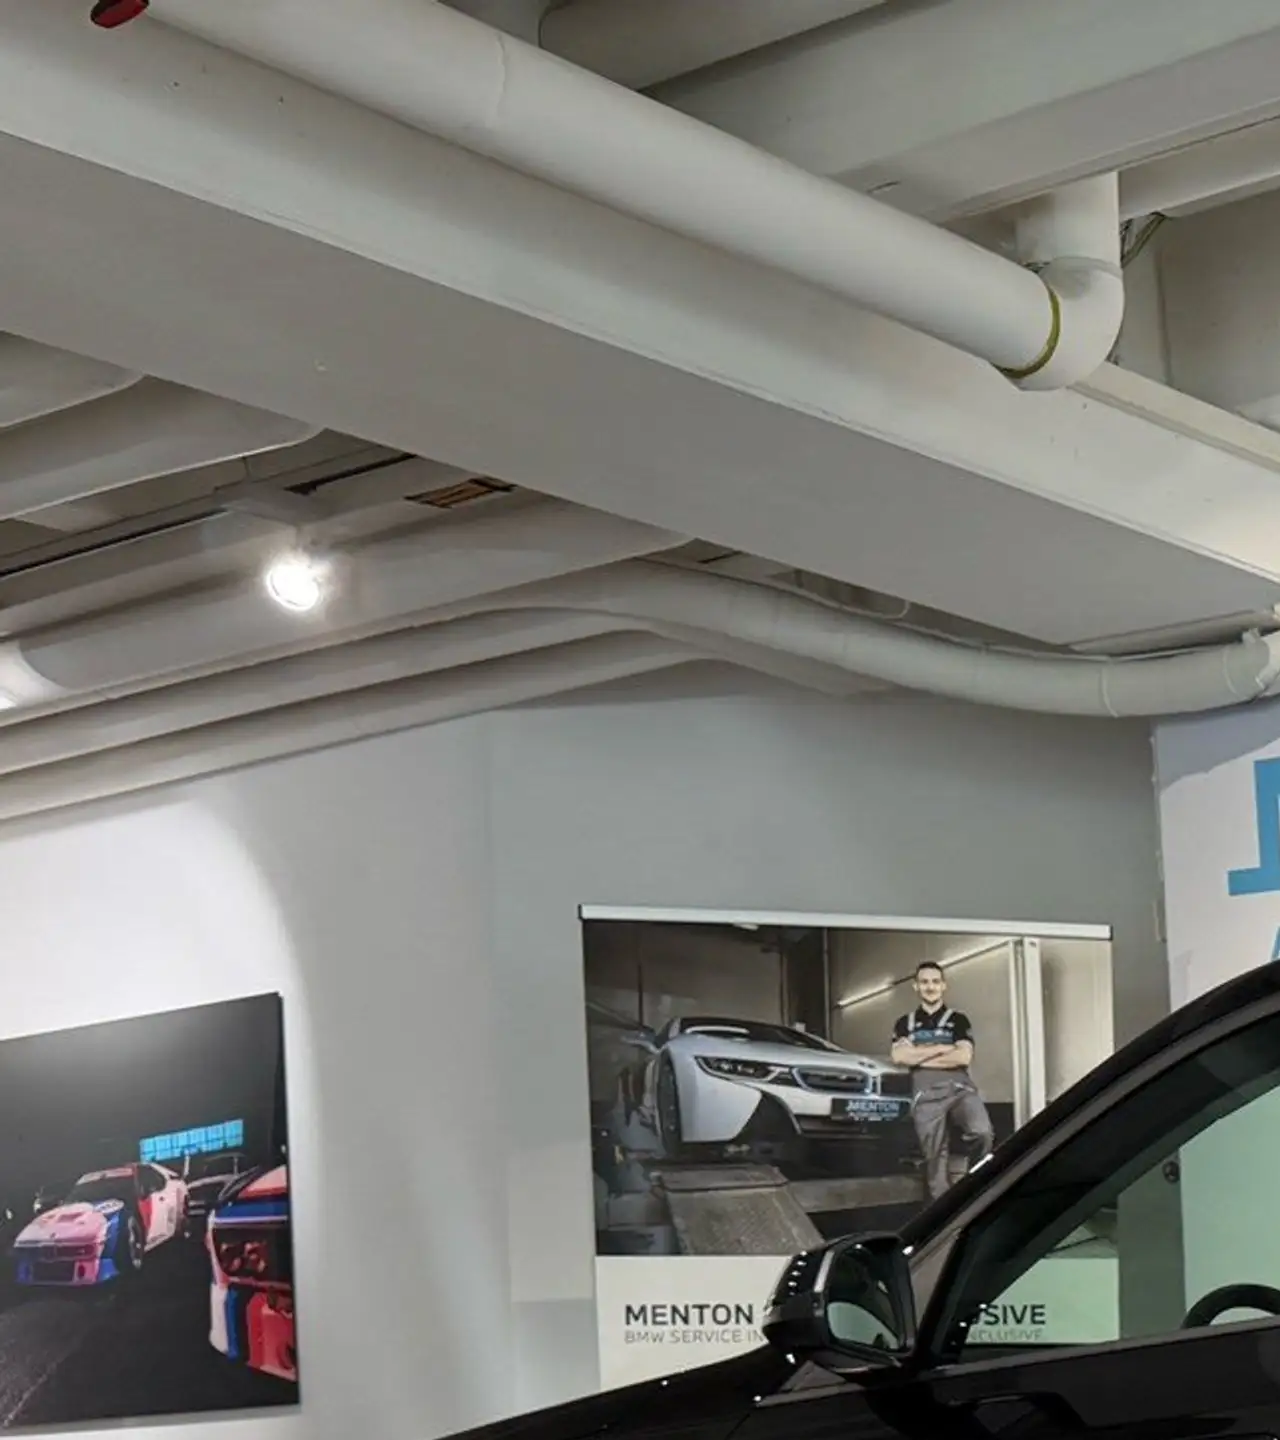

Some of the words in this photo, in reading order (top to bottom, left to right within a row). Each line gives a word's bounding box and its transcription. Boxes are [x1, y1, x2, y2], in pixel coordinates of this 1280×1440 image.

[624, 1303, 753, 1326] MENTON
[624, 1330, 666, 1344] BMW
[669, 1329, 742, 1344] SERVICE
